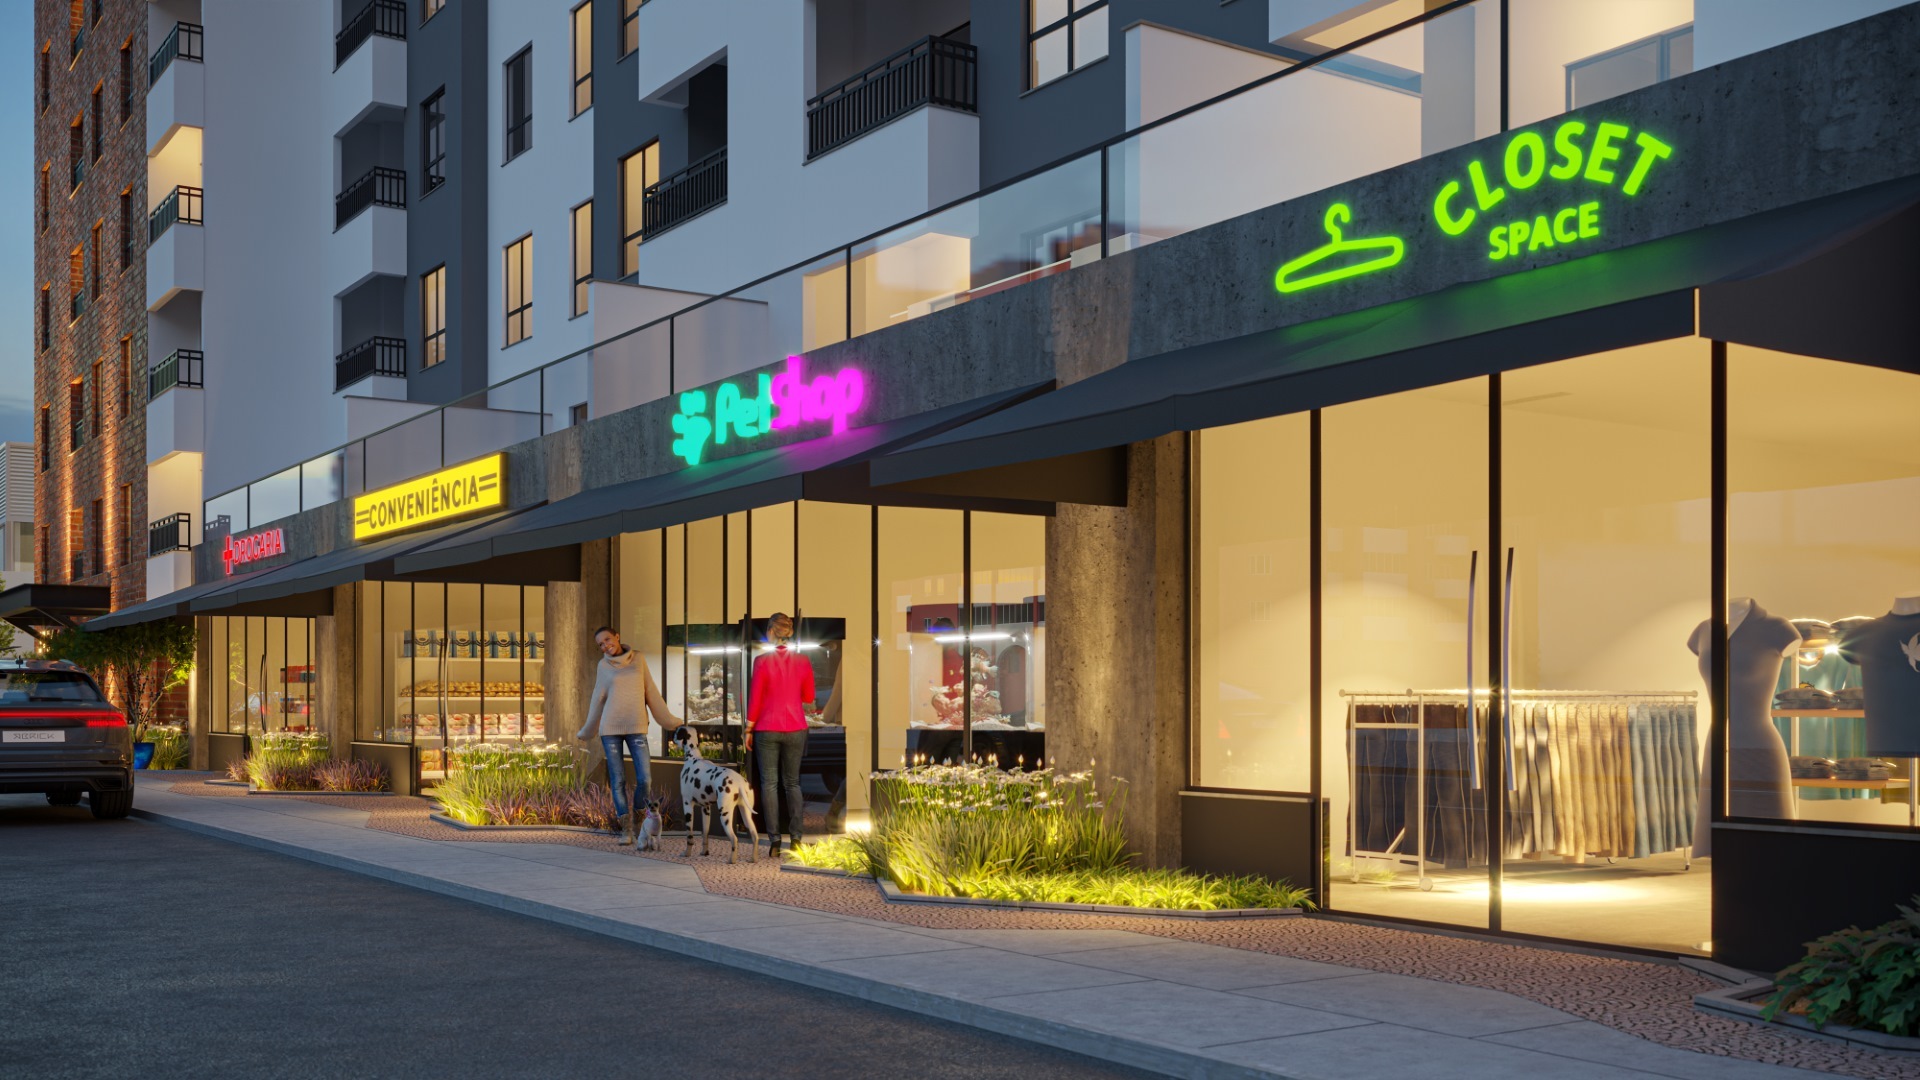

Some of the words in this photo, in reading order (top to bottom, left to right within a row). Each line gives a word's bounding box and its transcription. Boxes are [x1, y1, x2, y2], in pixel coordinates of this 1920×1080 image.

[1433, 121, 1672, 236] CLOSET
[1488, 201, 1599, 260] SPACE
[369, 475, 479, 530] CONVENIÊNCIA
[233, 528, 284, 565] DROGARIA
